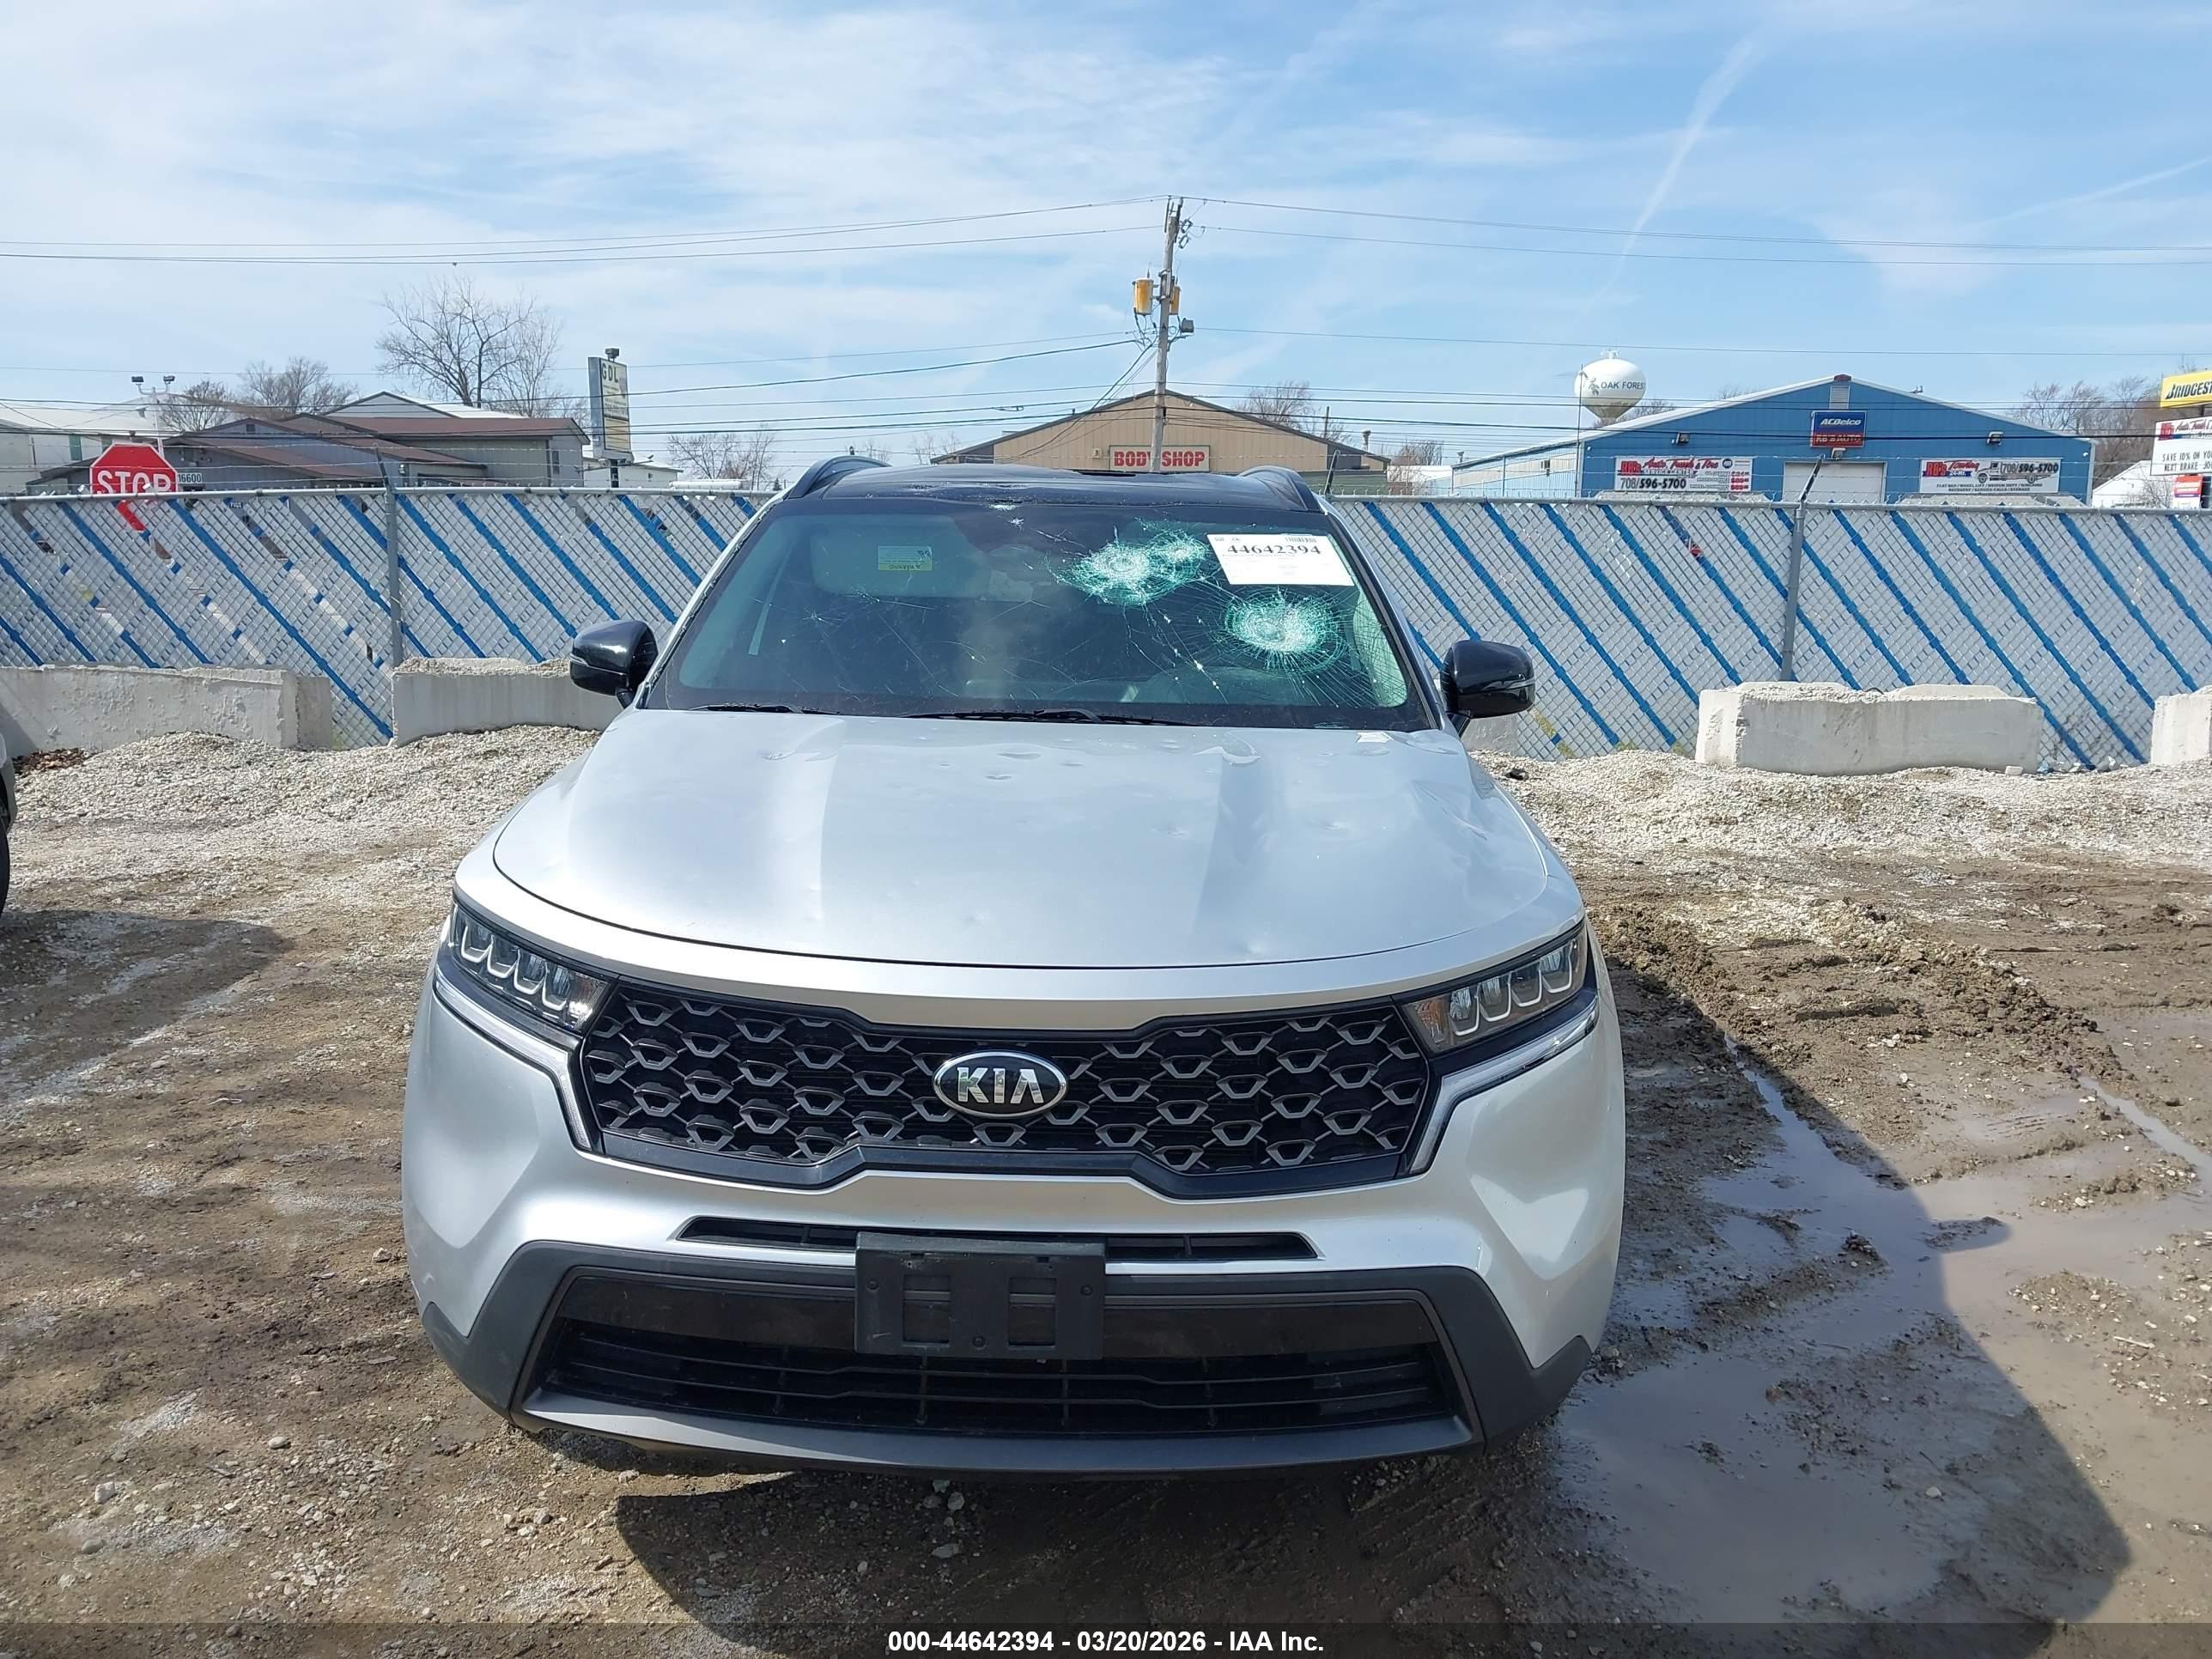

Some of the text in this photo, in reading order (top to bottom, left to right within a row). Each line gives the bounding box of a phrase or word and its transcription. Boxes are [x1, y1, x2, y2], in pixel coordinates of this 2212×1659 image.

[1162, 451, 1205, 466] SHOP
[2162, 453, 2177, 462] SAVE
[2179, 453, 2191, 461] 10%
[2193, 451, 2200, 459] ON
[2179, 462, 2198, 471] BRAKE
[97, 471, 171, 494] STOP
[178, 473, 202, 483] 16600
[1620, 478, 1686, 489] 708/596-5700
[1228, 544, 1322, 555] 44642394
[957, 1066, 1044, 1103] KIA
